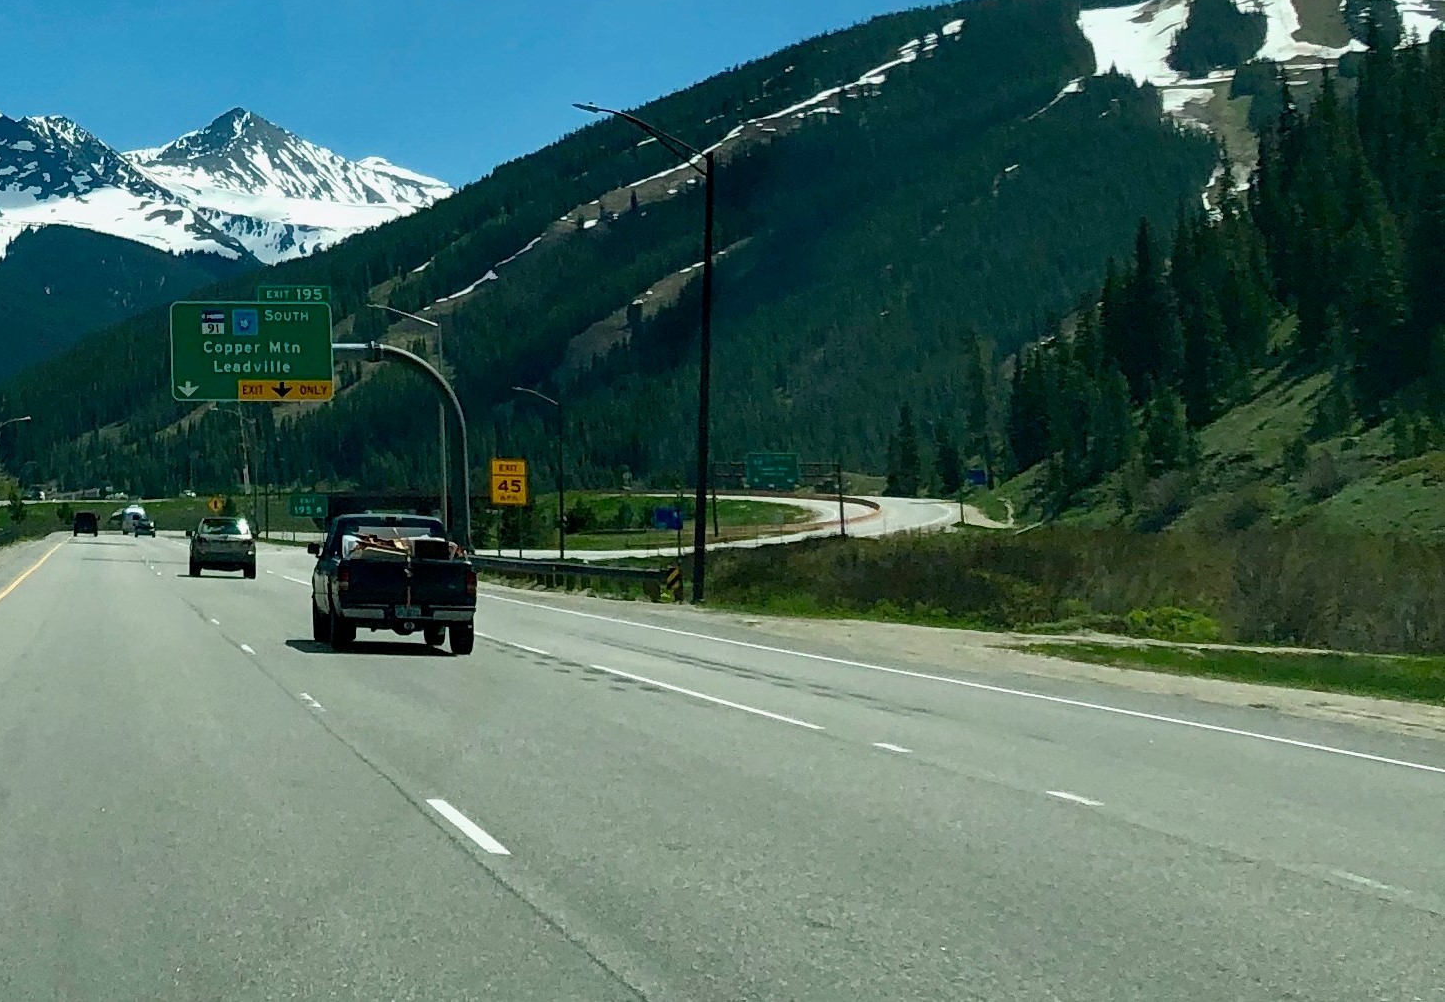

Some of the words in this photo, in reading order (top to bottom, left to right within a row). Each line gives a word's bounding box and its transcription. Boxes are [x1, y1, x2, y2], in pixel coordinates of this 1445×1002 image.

[266, 290, 289, 300] EXIT
[296, 288, 323, 301] 195
[207, 323, 220, 334] 91
[203, 341, 260, 356] Copper
[269, 341, 301, 354] Mtn
[213, 360, 291, 374] Leadville
[242, 384, 263, 395] EXIT
[299, 384, 328, 395] ONLY
[498, 479, 521, 492] 45
